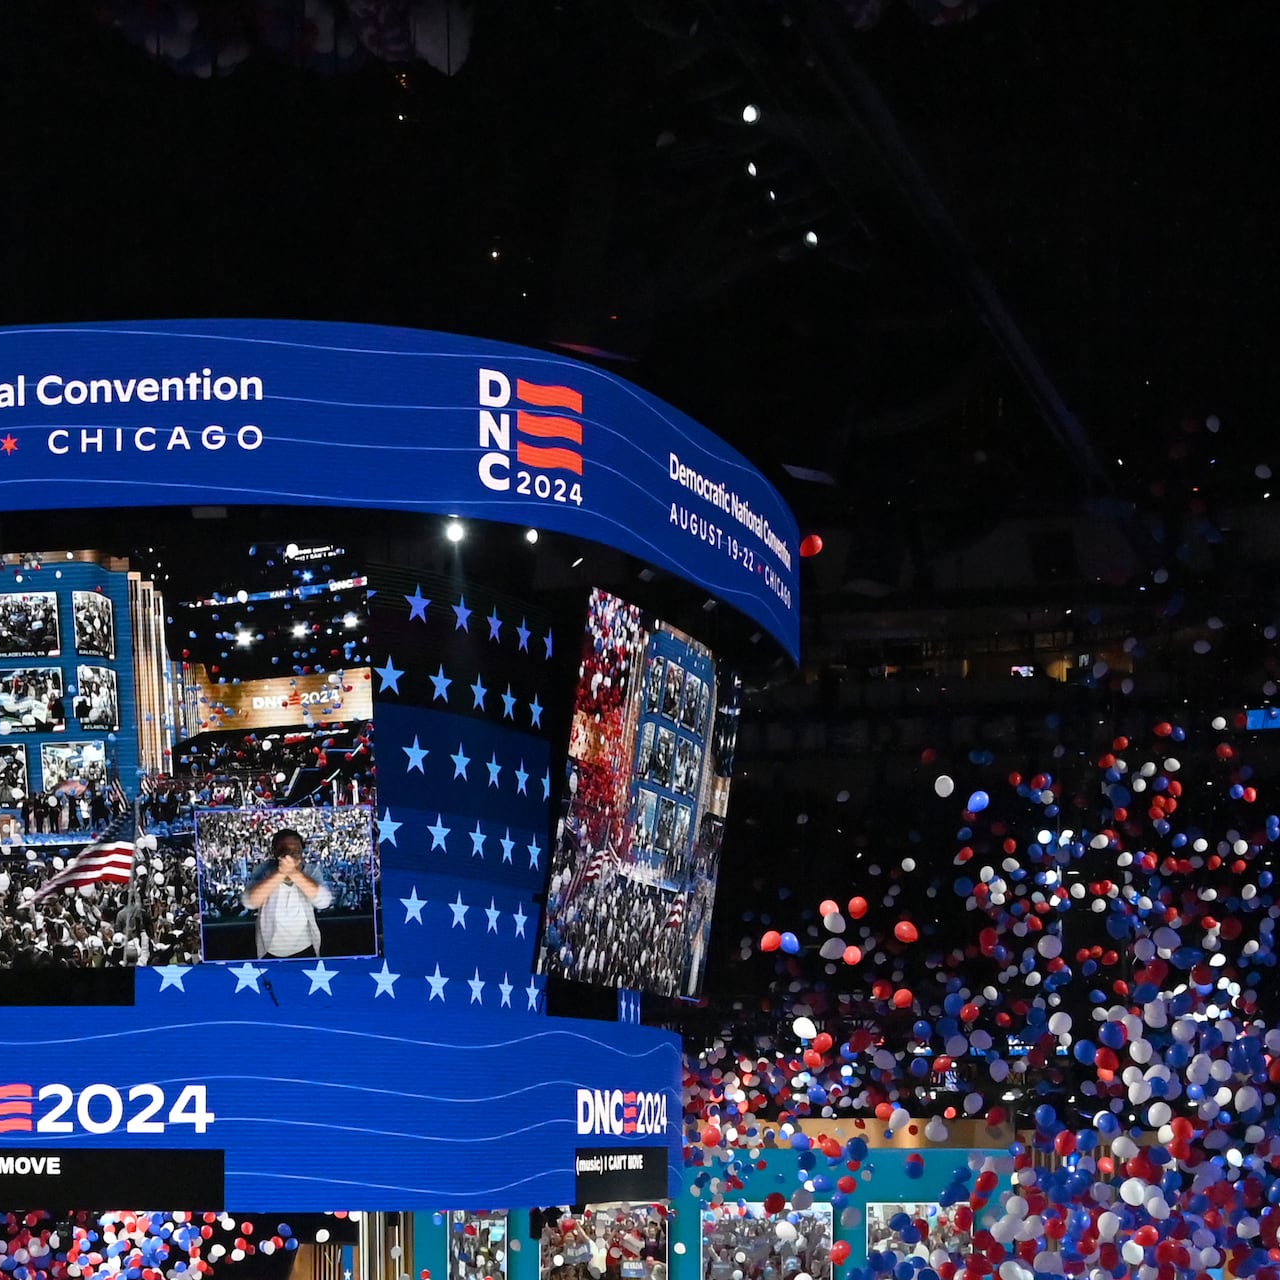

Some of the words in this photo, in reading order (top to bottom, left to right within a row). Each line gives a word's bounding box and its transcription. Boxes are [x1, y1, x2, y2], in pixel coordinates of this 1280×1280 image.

[36, 368, 264, 406] Convention
[47, 424, 264, 455] CHICAGO
[517, 471, 583, 506] 2024
[669, 452, 730, 509] Democratic
[730, 494, 763, 537] National
[763, 516, 793, 572] Convention
[669, 502, 722, 550] AUGUST
[727, 540, 755, 573] 19-22
[764, 565, 793, 609] CHICAGO
[37, 1084, 214, 1134] 2024
[576, 1155, 603, 1177] (music)
